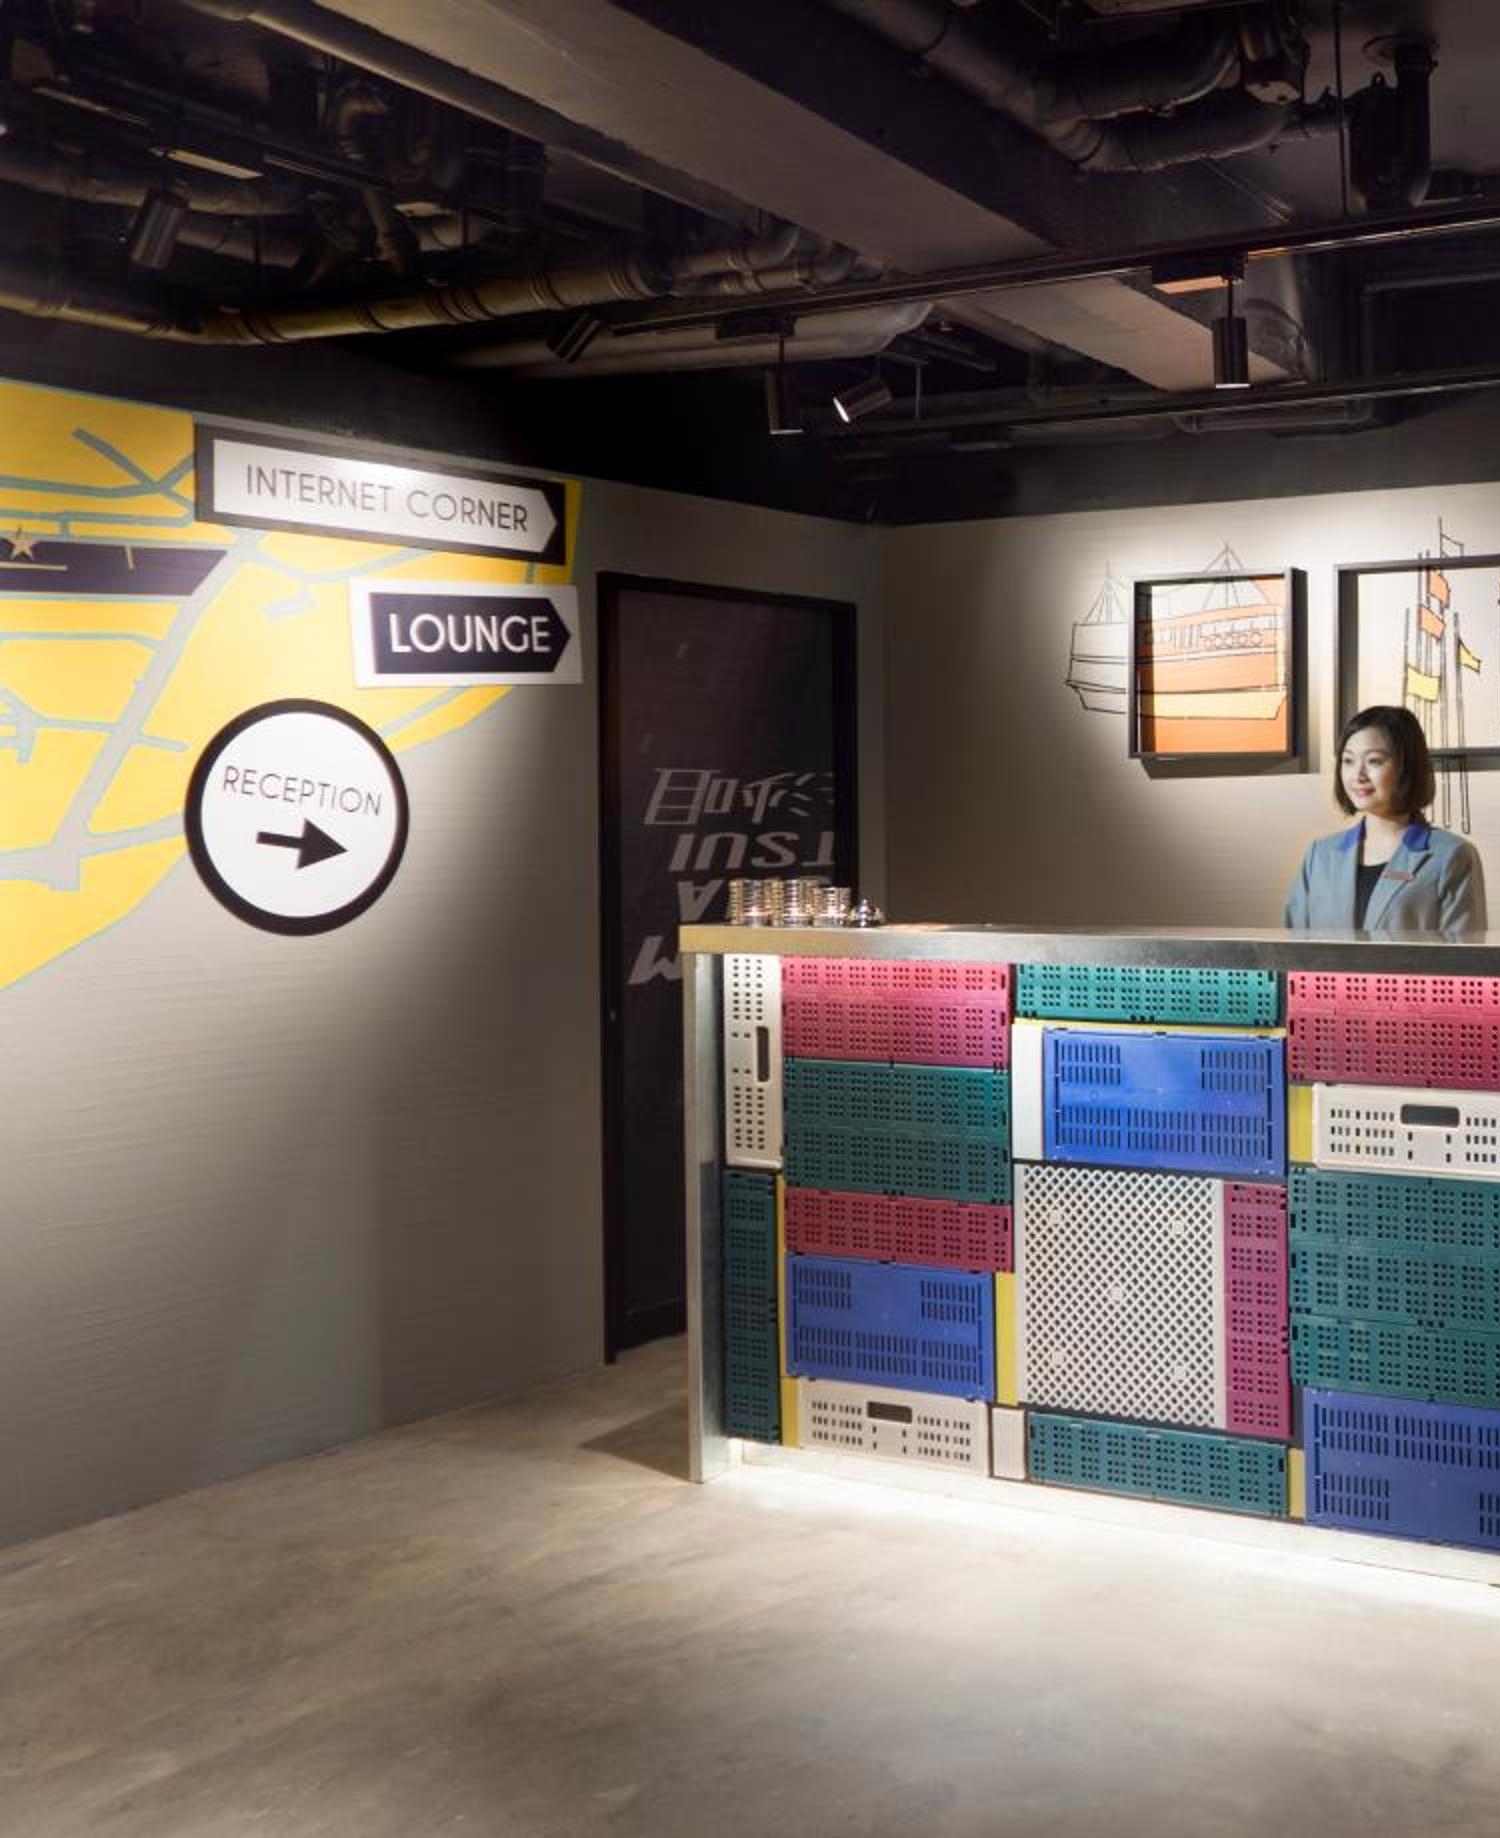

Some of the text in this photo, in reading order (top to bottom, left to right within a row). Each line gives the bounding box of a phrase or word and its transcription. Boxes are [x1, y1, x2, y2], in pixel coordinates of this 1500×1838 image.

[245, 463, 529, 532] INTERNET CORNER
[389, 613, 551, 653] LOUNGE
[223, 765, 382, 816] RECEPTION
